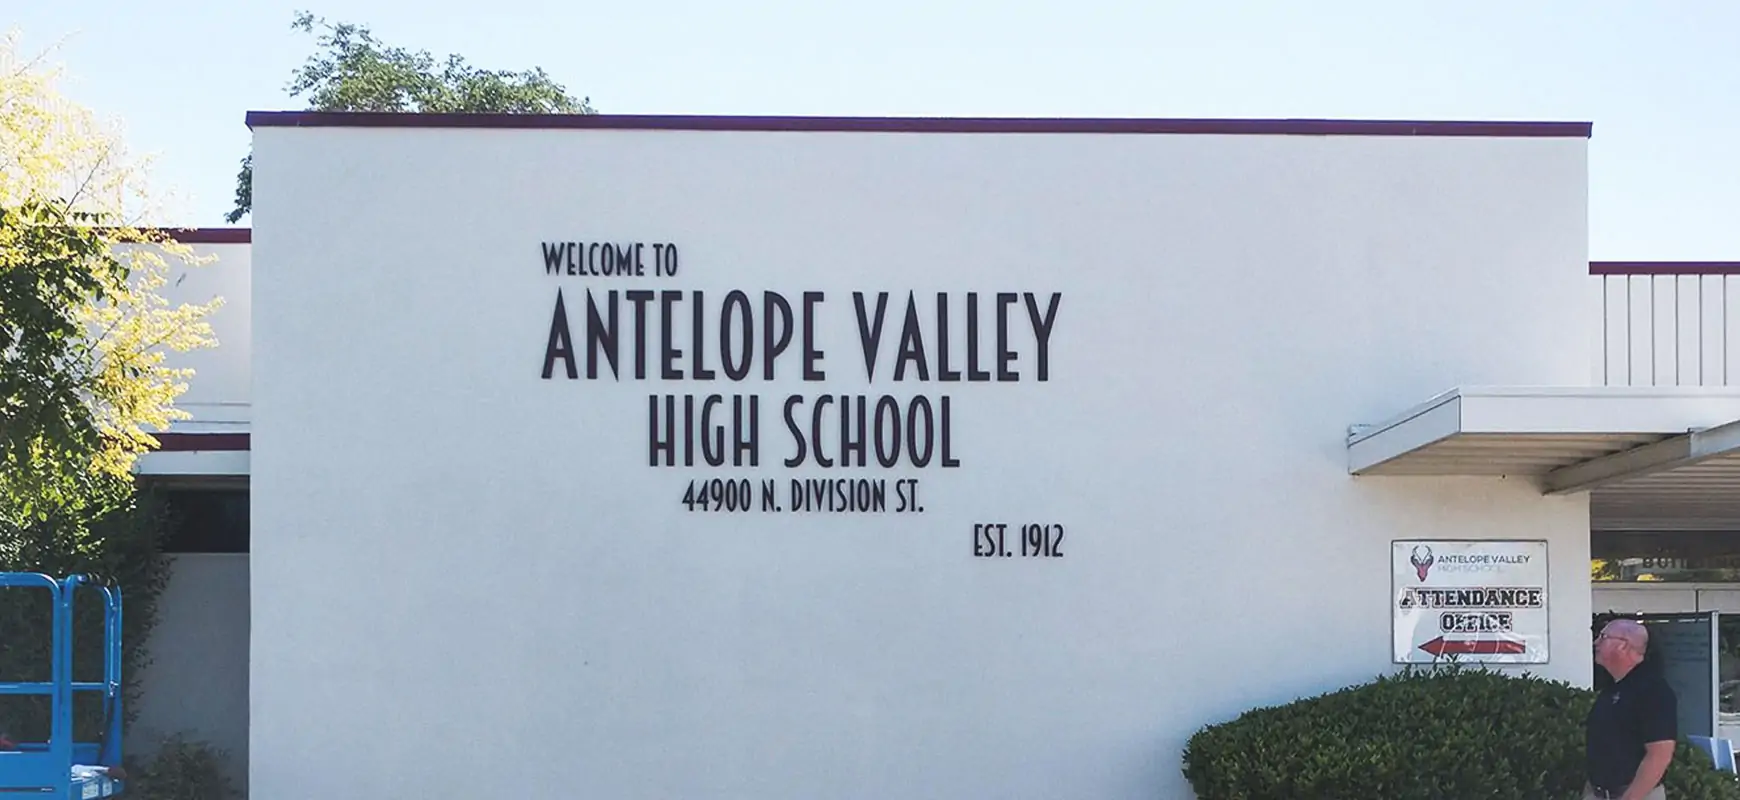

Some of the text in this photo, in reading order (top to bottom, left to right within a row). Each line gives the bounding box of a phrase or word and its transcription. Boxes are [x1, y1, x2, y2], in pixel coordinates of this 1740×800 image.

[541, 241, 678, 277] WELCOME TO
[541, 288, 1062, 384] ANTELOPE VALLEY
[648, 394, 961, 469] HIGH SCHOOL
[681, 478, 924, 513] 44900 N. DIVISION ST.
[973, 523, 1064, 558] EST. 1912
[1437, 555, 1531, 564] ANTELOPE VALLEY
[1400, 588, 1542, 607] ATTENDANCE
[1441, 612, 1512, 632] OFFICE
